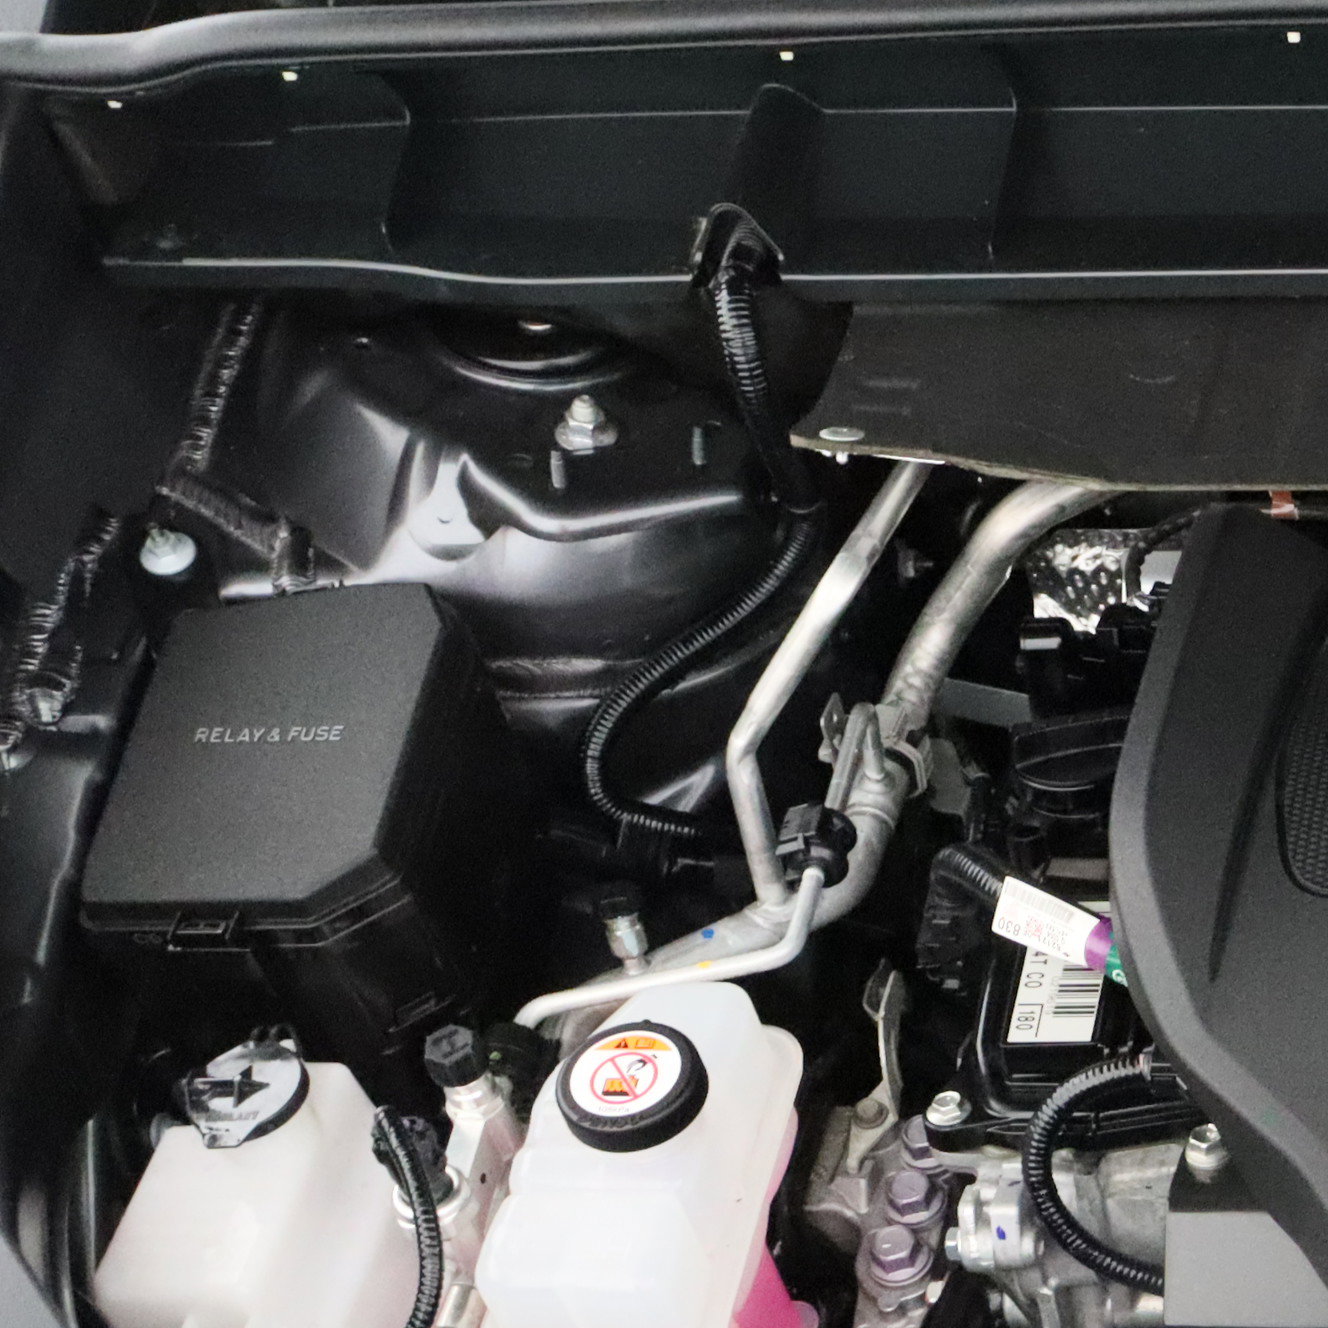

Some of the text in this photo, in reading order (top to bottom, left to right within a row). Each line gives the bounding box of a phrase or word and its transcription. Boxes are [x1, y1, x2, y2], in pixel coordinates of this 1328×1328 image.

[194, 725, 345, 743] RELAY & FUSE
[1015, 1010, 1035, 1031] 180
